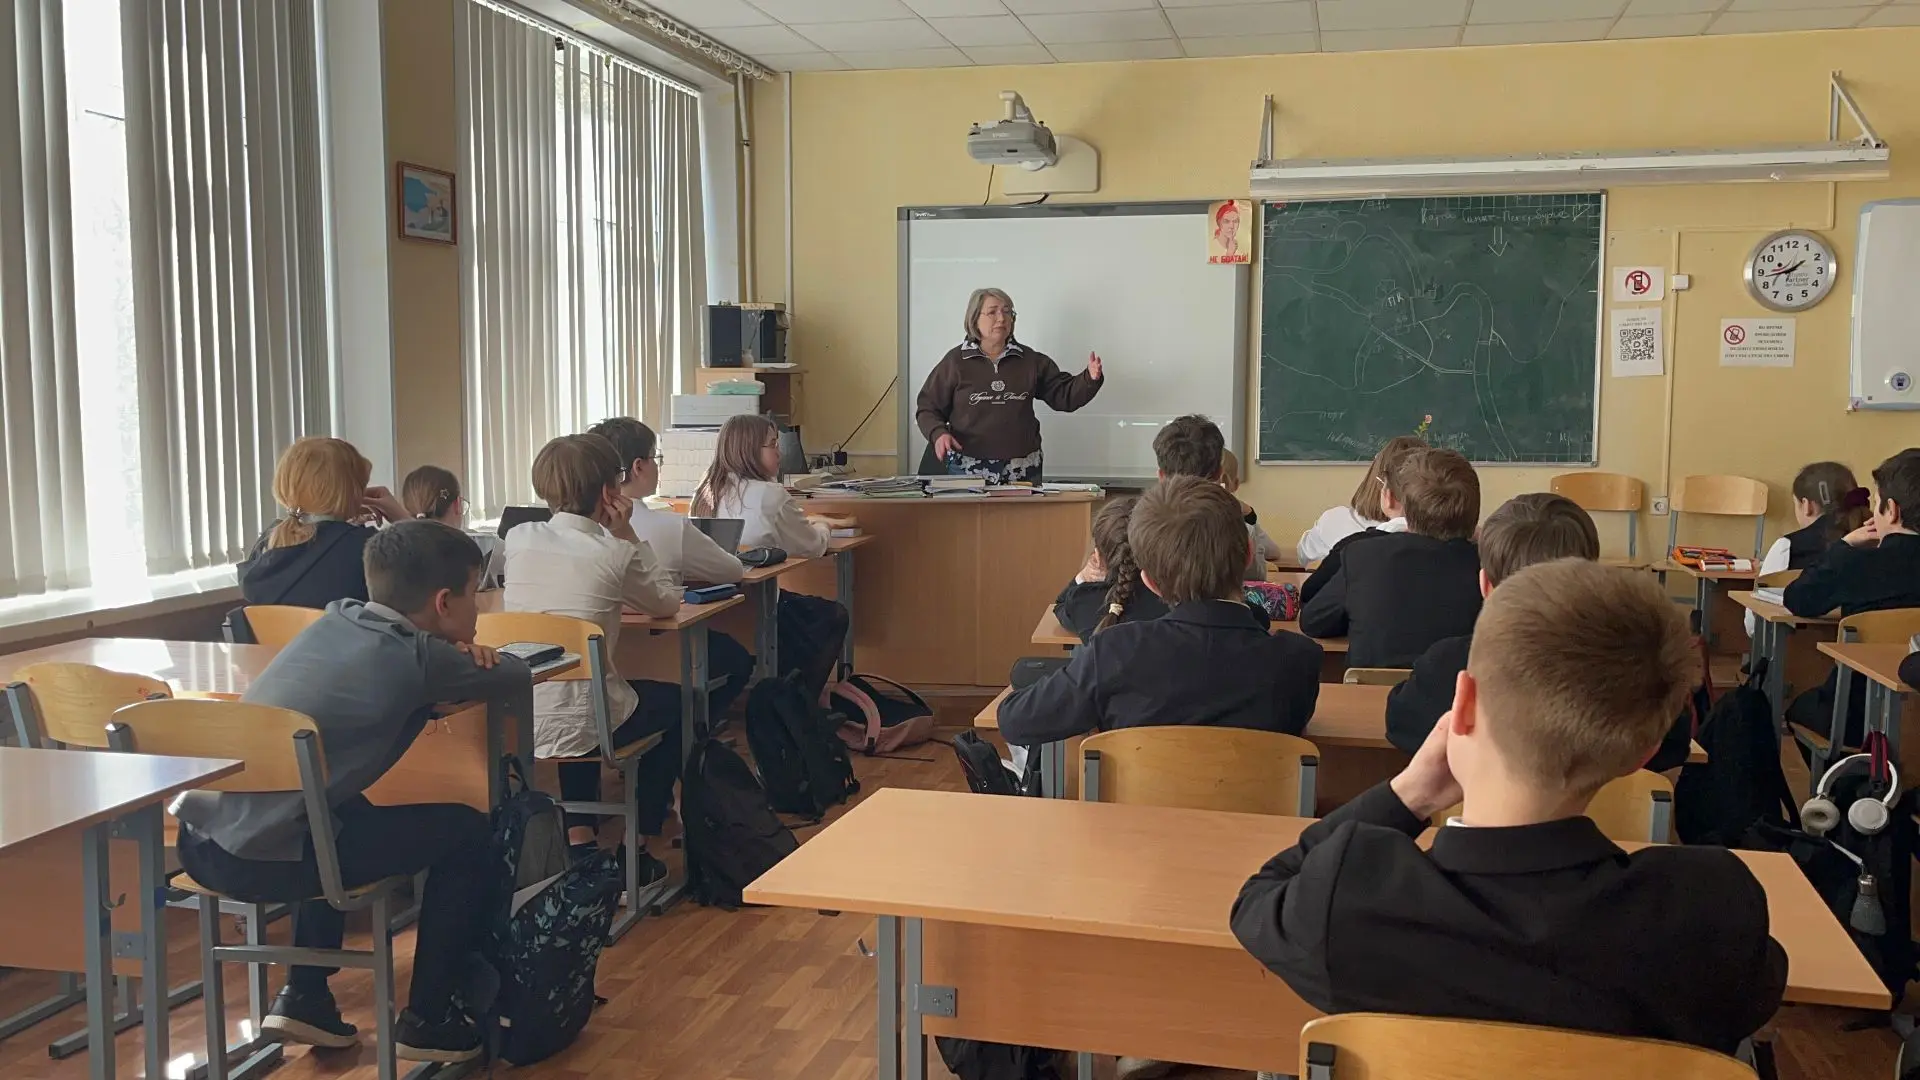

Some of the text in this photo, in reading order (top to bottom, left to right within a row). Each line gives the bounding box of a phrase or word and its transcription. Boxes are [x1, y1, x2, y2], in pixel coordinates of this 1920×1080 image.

[1771, 245, 1784, 253] 11
[1785, 241, 1799, 249] 12
[1804, 243, 1810, 251] 1
[1221, 254, 1249, 263] БОЛТАЙ!
[1760, 255, 1774, 263] 10
[1813, 253, 1821, 261] 2
[1757, 269, 1765, 277] 9
[1816, 267, 1824, 275] 3
[1762, 281, 1769, 289] 8
[1811, 279, 1819, 287] 4
[1772, 291, 1780, 299] 7
[1786, 293, 1793, 301] 6
[1801, 290, 1808, 298] 5
